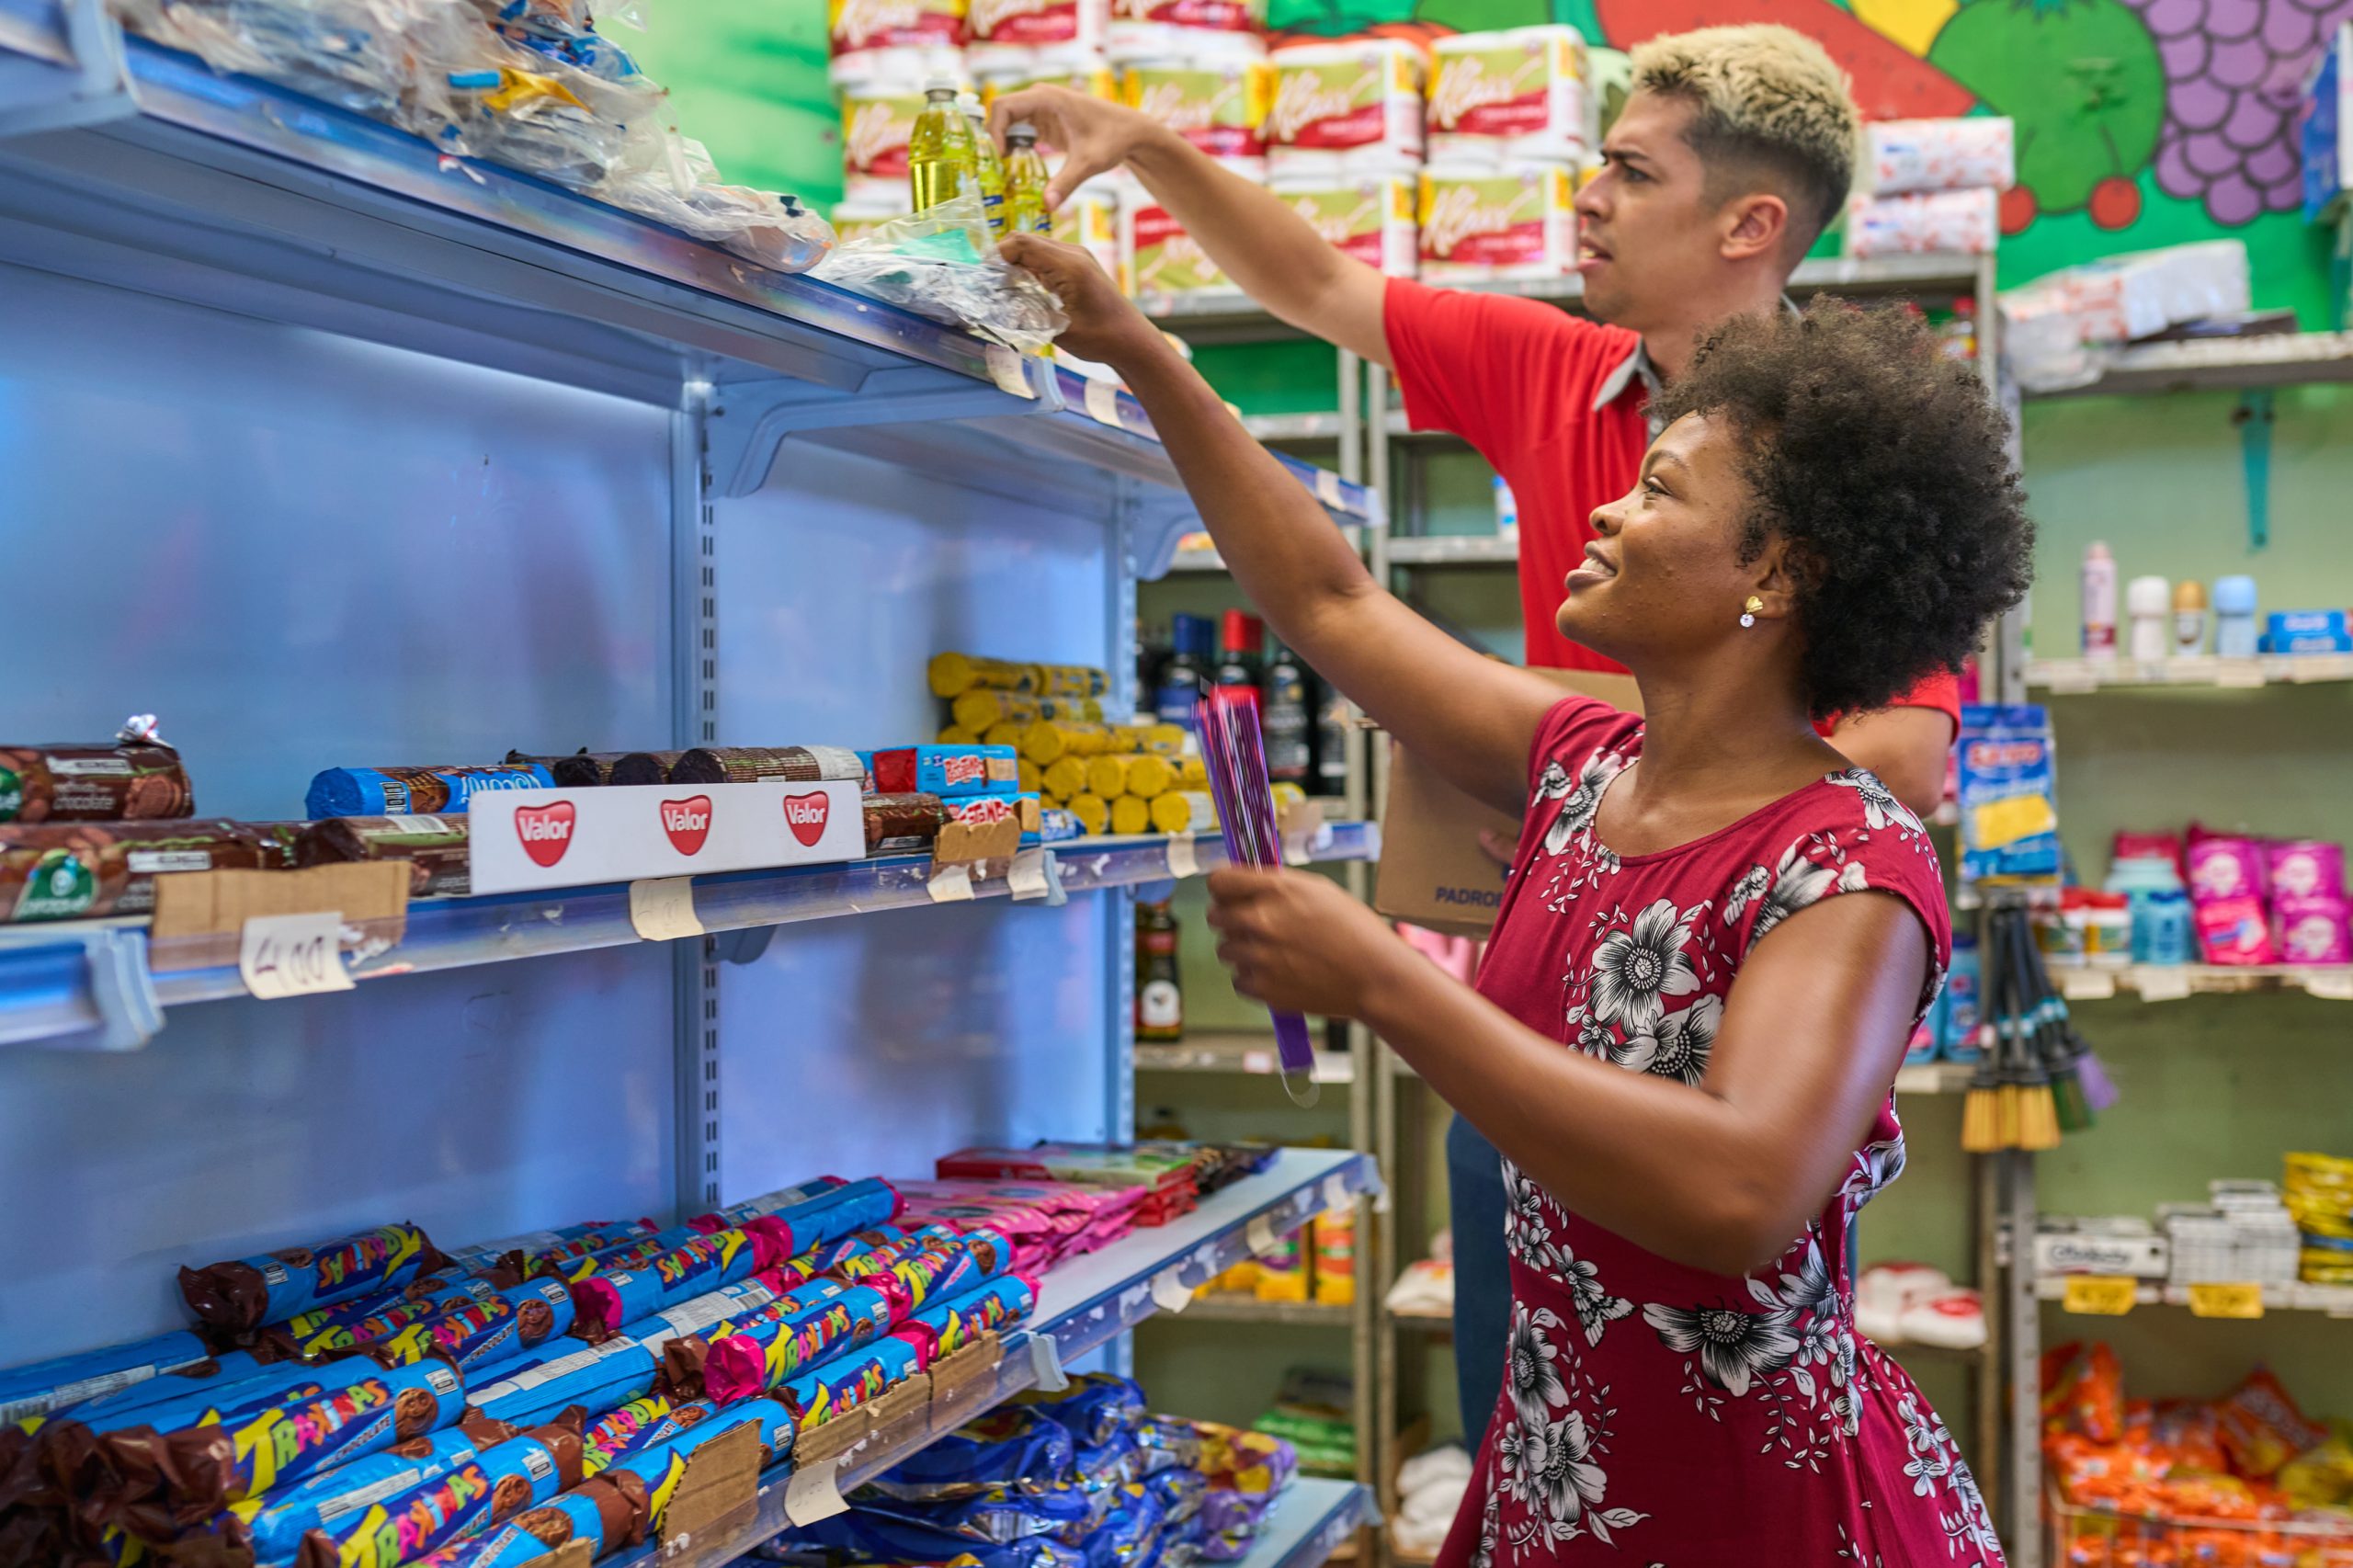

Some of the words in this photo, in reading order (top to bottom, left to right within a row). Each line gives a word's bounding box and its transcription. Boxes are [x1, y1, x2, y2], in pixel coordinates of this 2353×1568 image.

[518, 814, 571, 841] Valor
[665, 806, 709, 832] Valor
[786, 803, 826, 826] Valor
